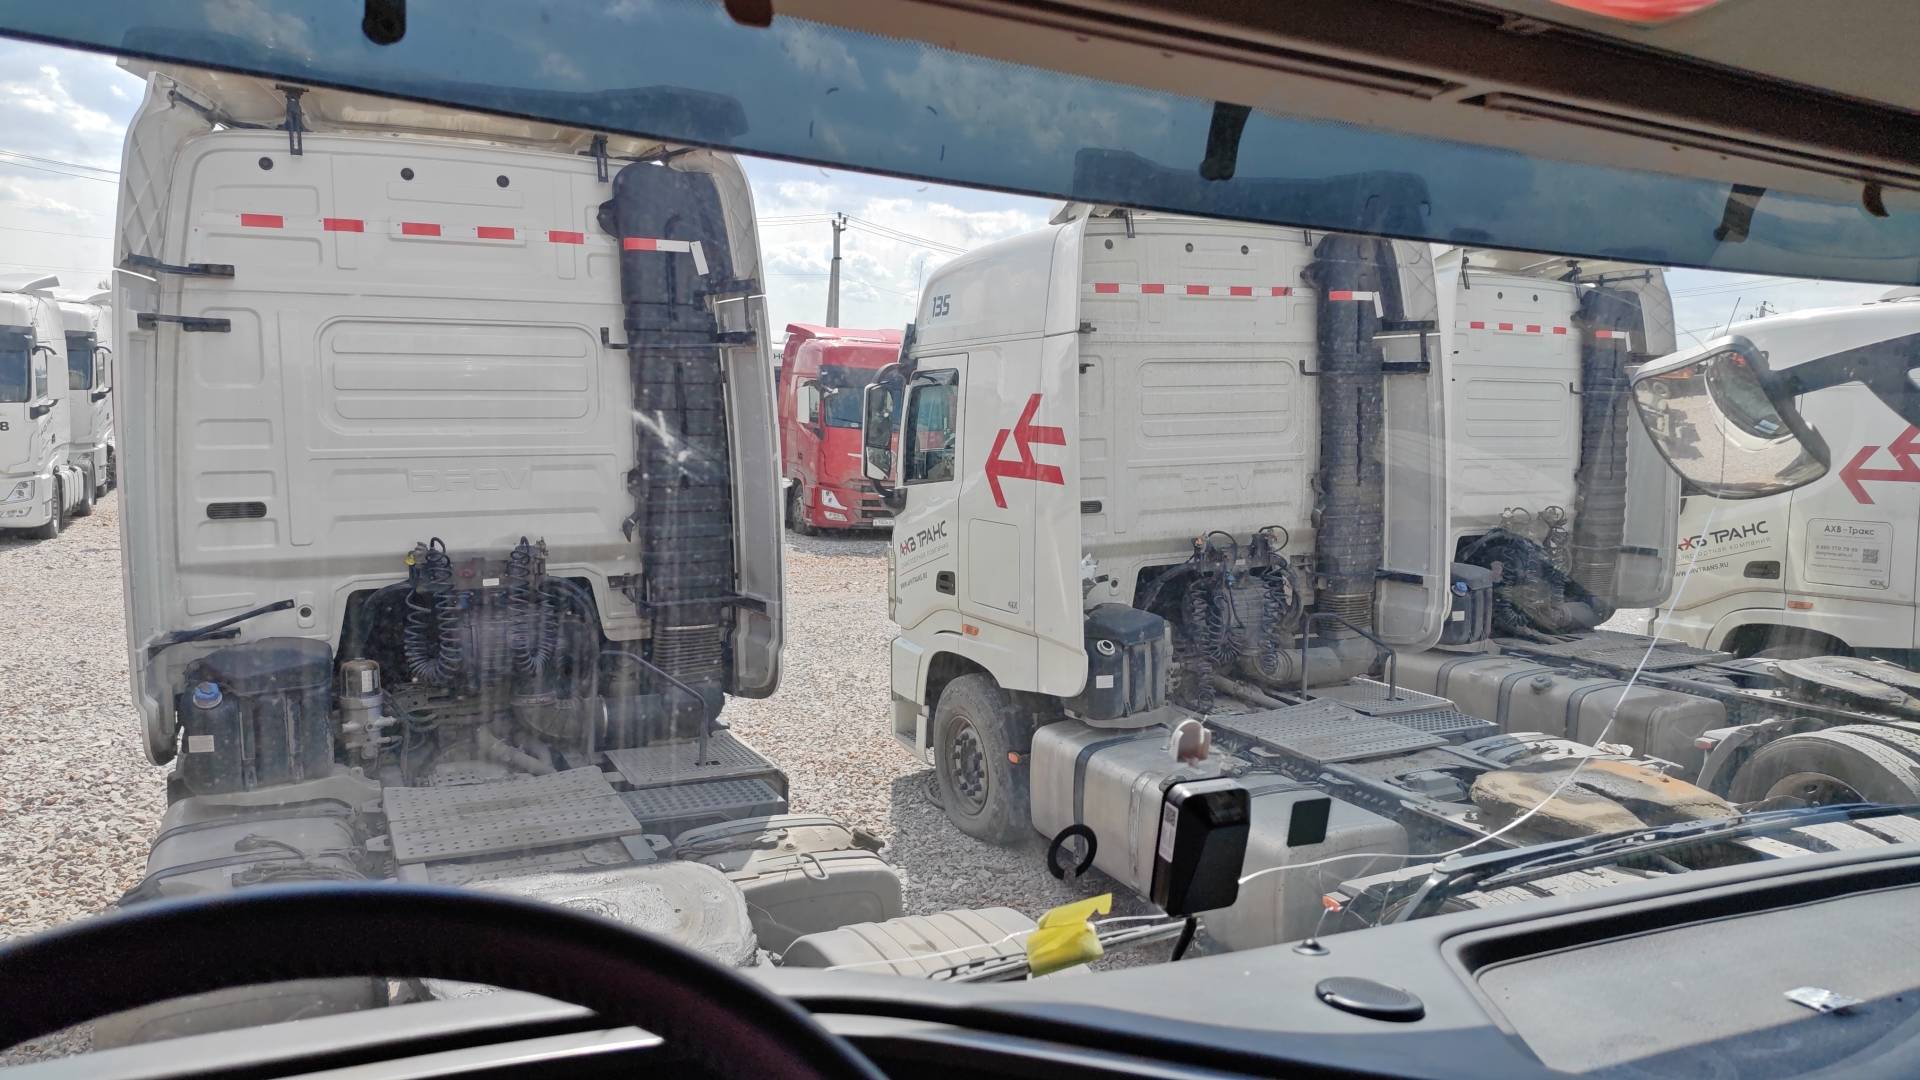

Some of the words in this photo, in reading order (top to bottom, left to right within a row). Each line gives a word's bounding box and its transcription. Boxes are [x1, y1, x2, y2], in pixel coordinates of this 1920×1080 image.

[932, 294, 951, 318] 135
[409, 467, 530, 493] DFCV
[916, 519, 948, 549] ТРАНС
[1708, 520, 1769, 544] ТРАНС
